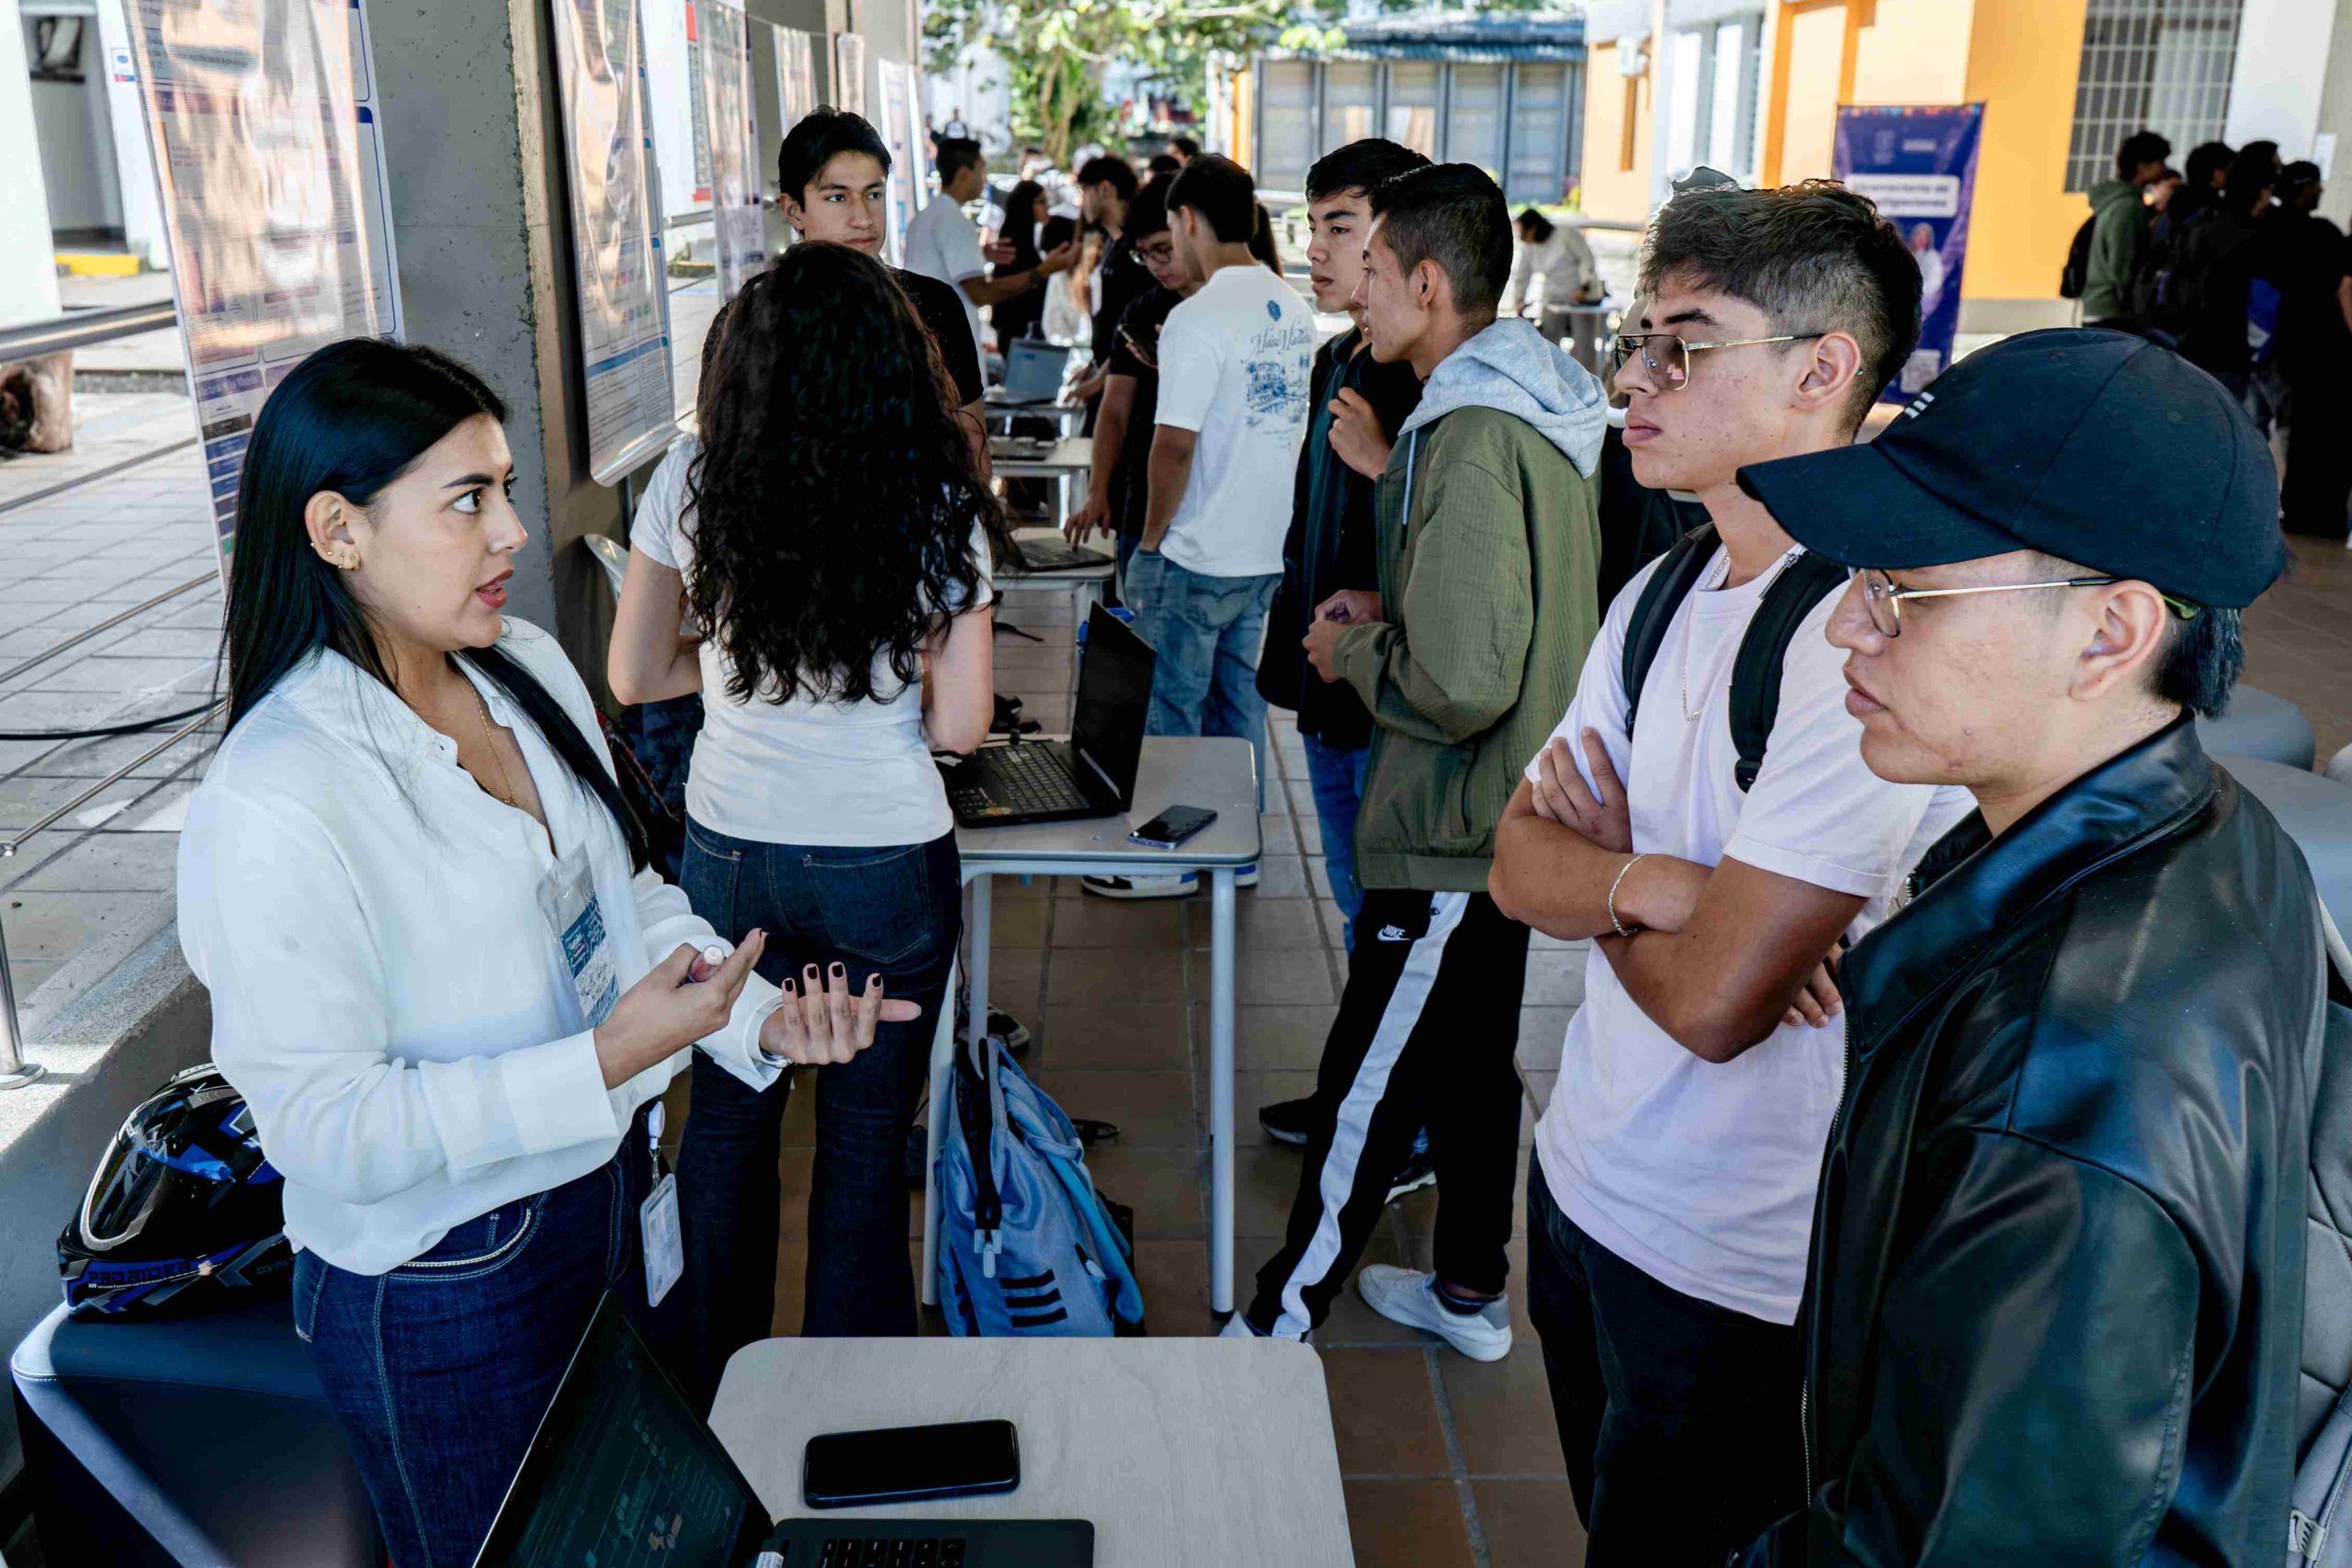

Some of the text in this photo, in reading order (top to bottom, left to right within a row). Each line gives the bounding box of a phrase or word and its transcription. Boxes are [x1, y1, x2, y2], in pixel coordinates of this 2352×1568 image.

[1383, 924, 1406, 938] NIKE
[88, 1261, 190, 1283] PRO RIDER
